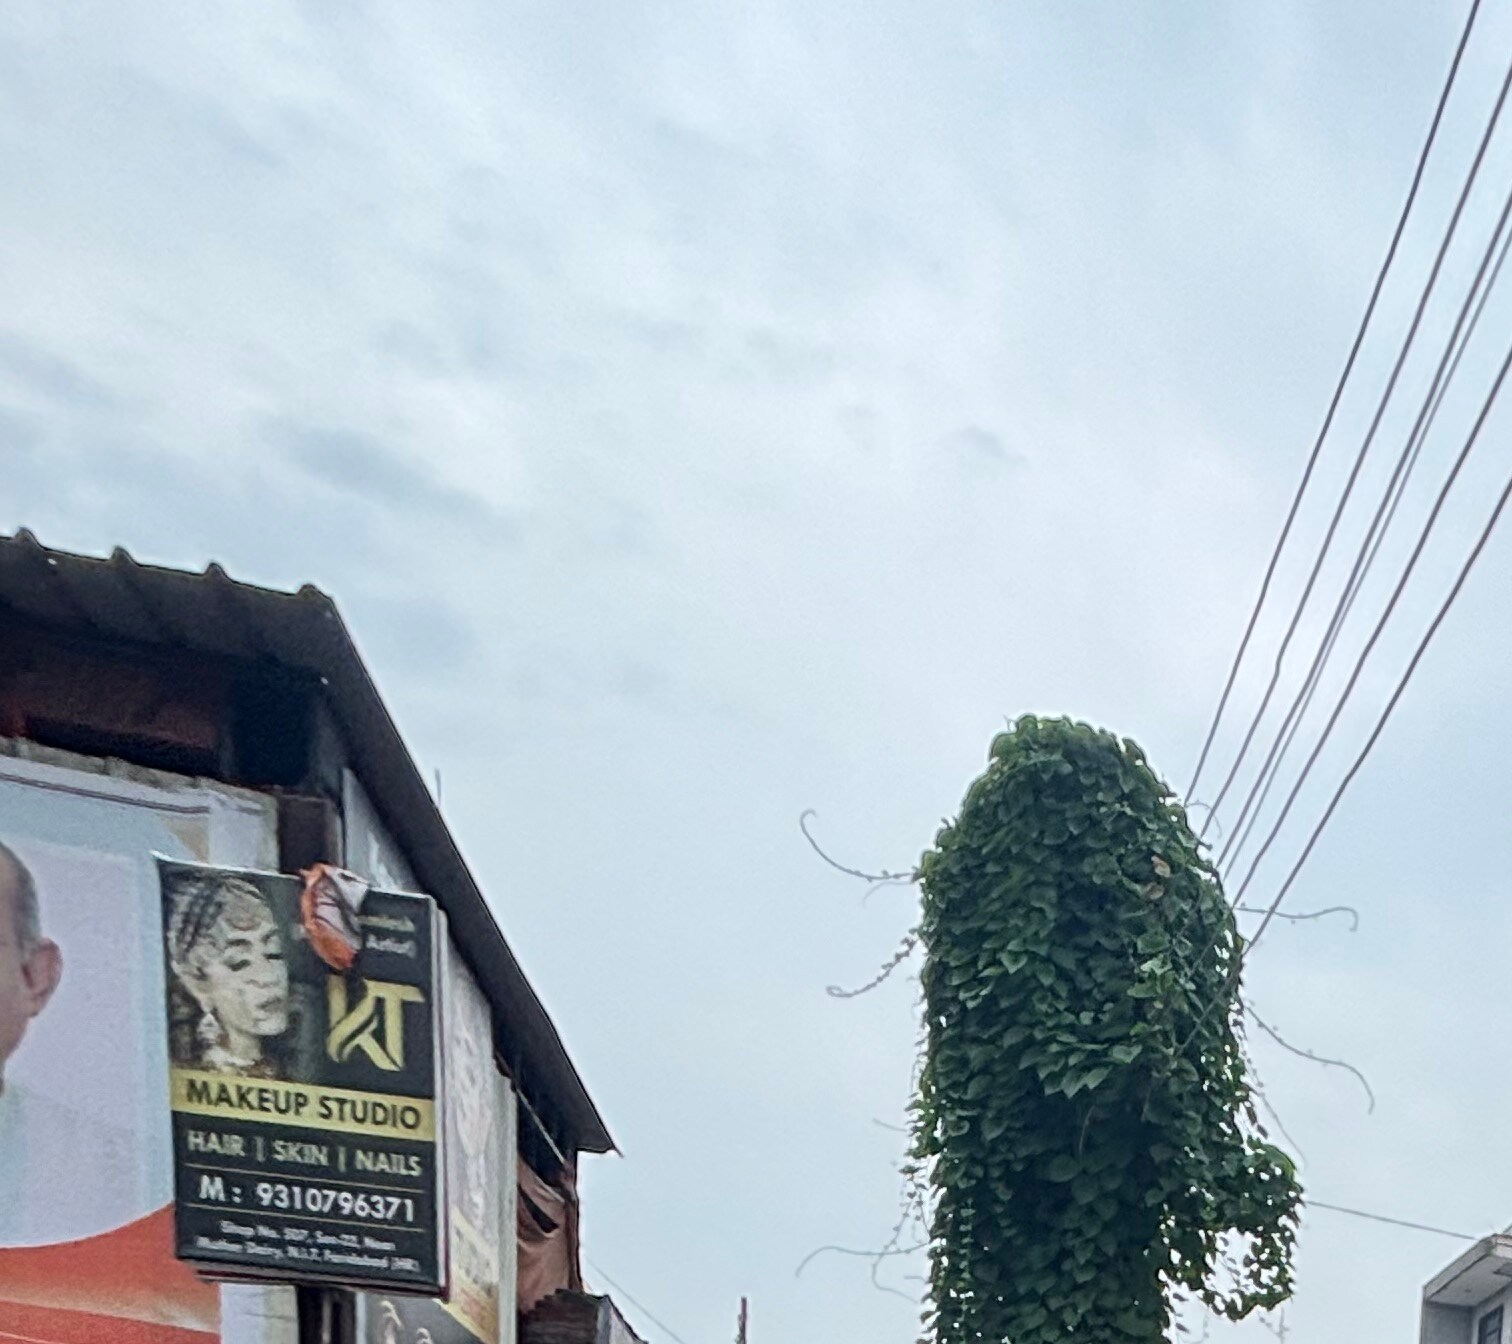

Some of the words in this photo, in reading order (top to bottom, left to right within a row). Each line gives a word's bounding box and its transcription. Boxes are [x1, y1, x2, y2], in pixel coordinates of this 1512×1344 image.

[326, 973, 426, 1072] KT
[185, 1078, 310, 1116] MAKEUP
[317, 1095, 421, 1130] STUDIO
[186, 1129, 246, 1158] HAIR
[272, 1140, 330, 1167] SKIN
[354, 1149, 423, 1177] NAILS
[256, 1182, 415, 1222] 9310796371
